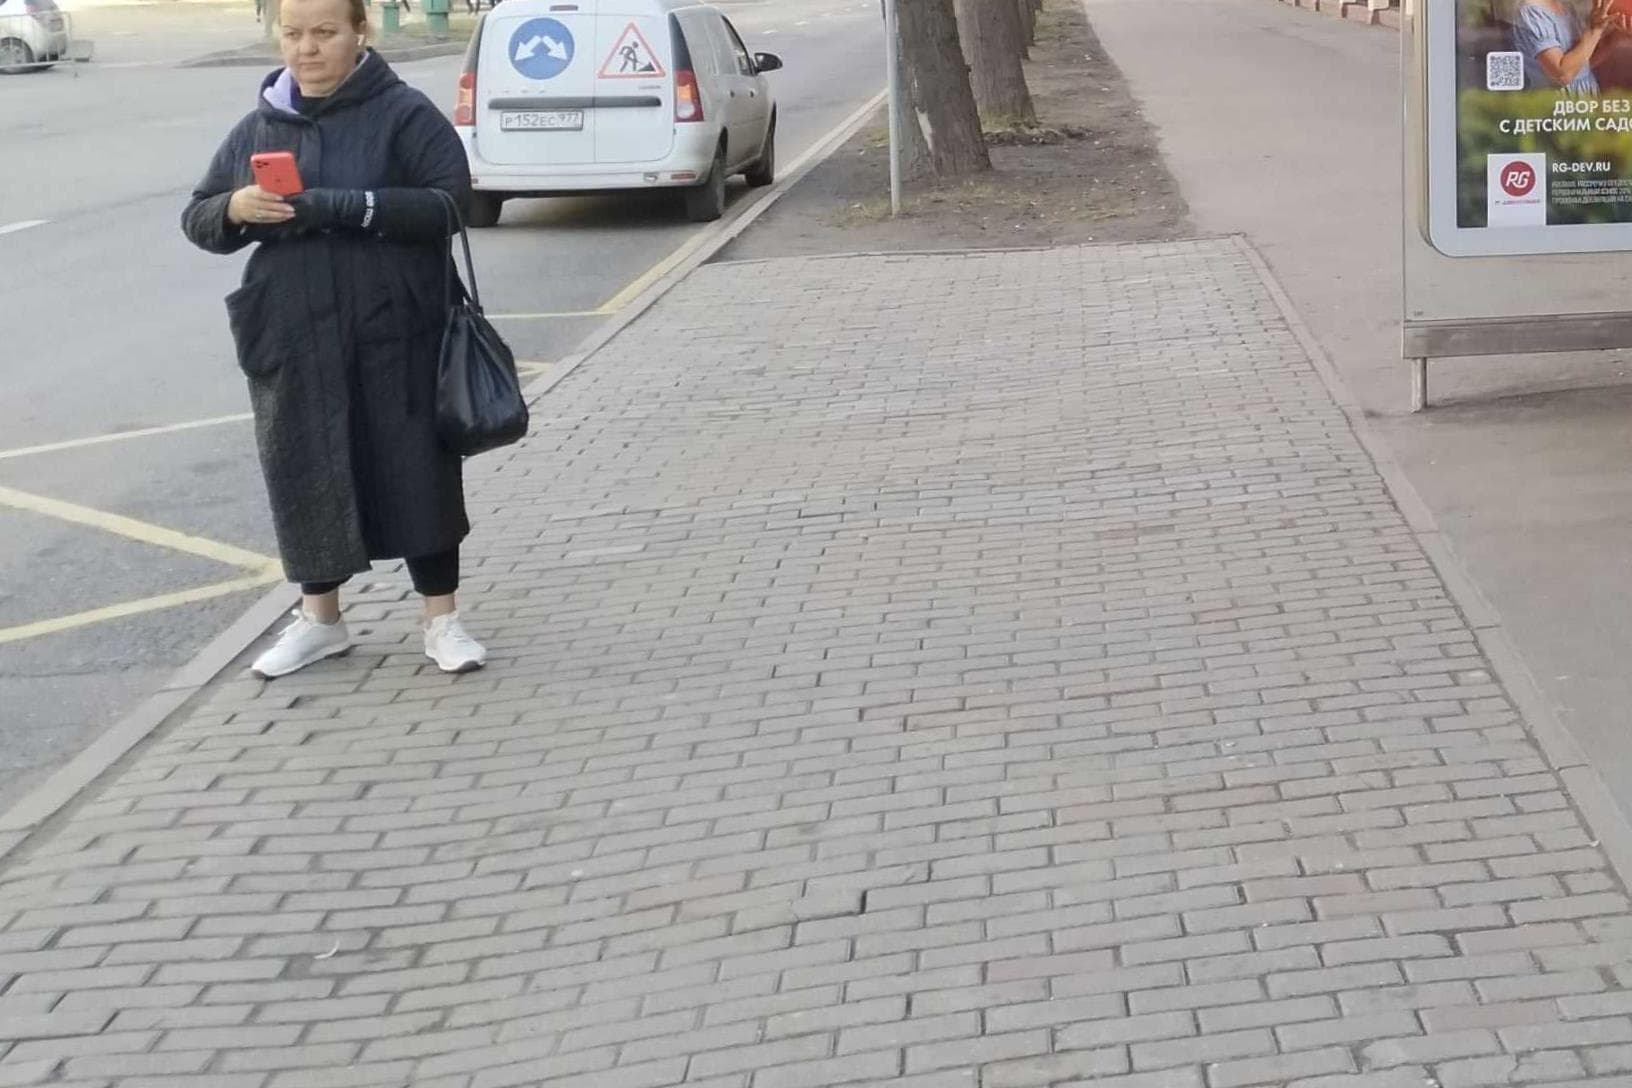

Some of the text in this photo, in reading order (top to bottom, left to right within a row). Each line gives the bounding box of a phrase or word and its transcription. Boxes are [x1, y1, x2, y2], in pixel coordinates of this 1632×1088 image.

[1553, 100, 1599, 116] ДВОР
[1602, 100, 1631, 113] БЕЗ
[1499, 119, 1511, 133] С
[1513, 116, 1591, 135] ДЕТСКИМ
[1552, 162, 1611, 173] RG-DEV.RU
[1505, 171, 1531, 189] RG
